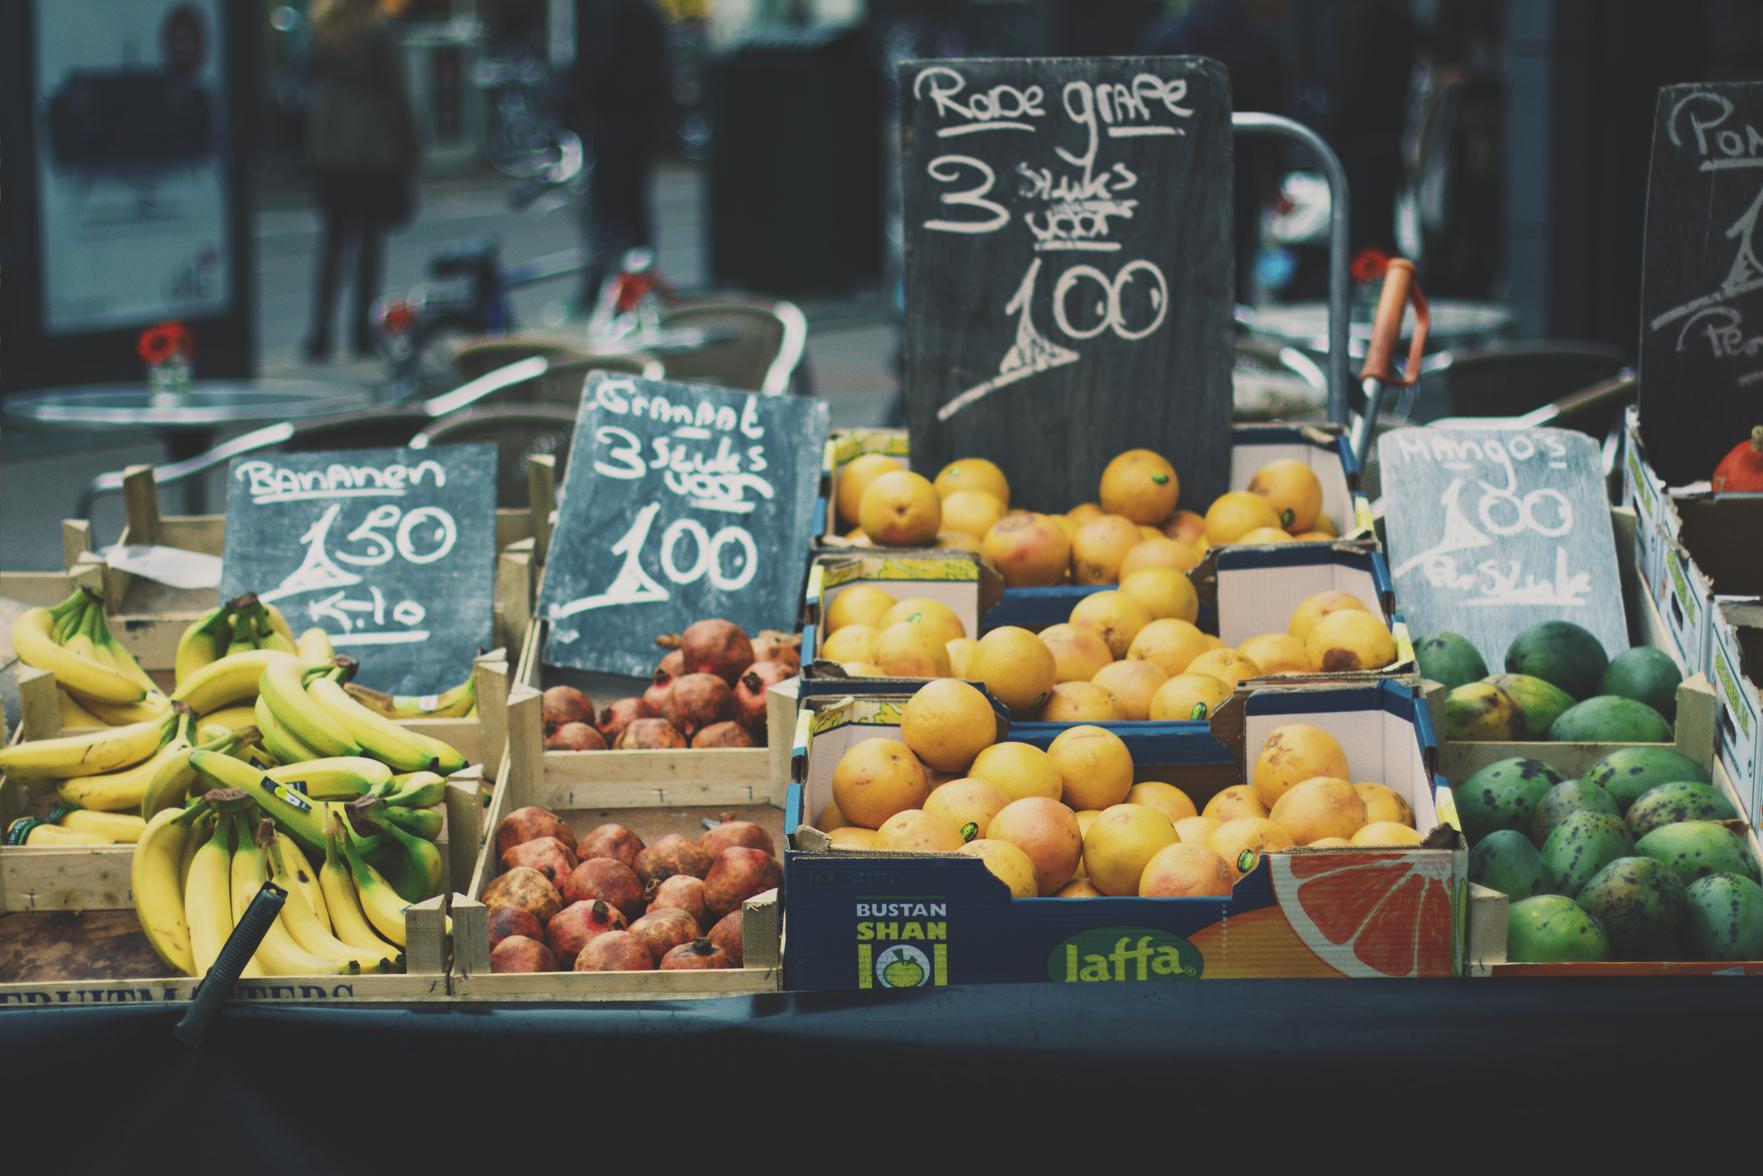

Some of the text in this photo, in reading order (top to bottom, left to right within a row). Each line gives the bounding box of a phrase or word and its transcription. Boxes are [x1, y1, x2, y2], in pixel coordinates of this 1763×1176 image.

[923, 154, 1010, 233] 3
[938, 257, 1168, 420] 100
[594, 426, 646, 479] 3
[257, 503, 457, 604] 150
[550, 501, 758, 619] 100
[1393, 477, 1574, 579] 100
[856, 903, 947, 917] BUSTAN
[856, 921, 947, 940] SHAN
